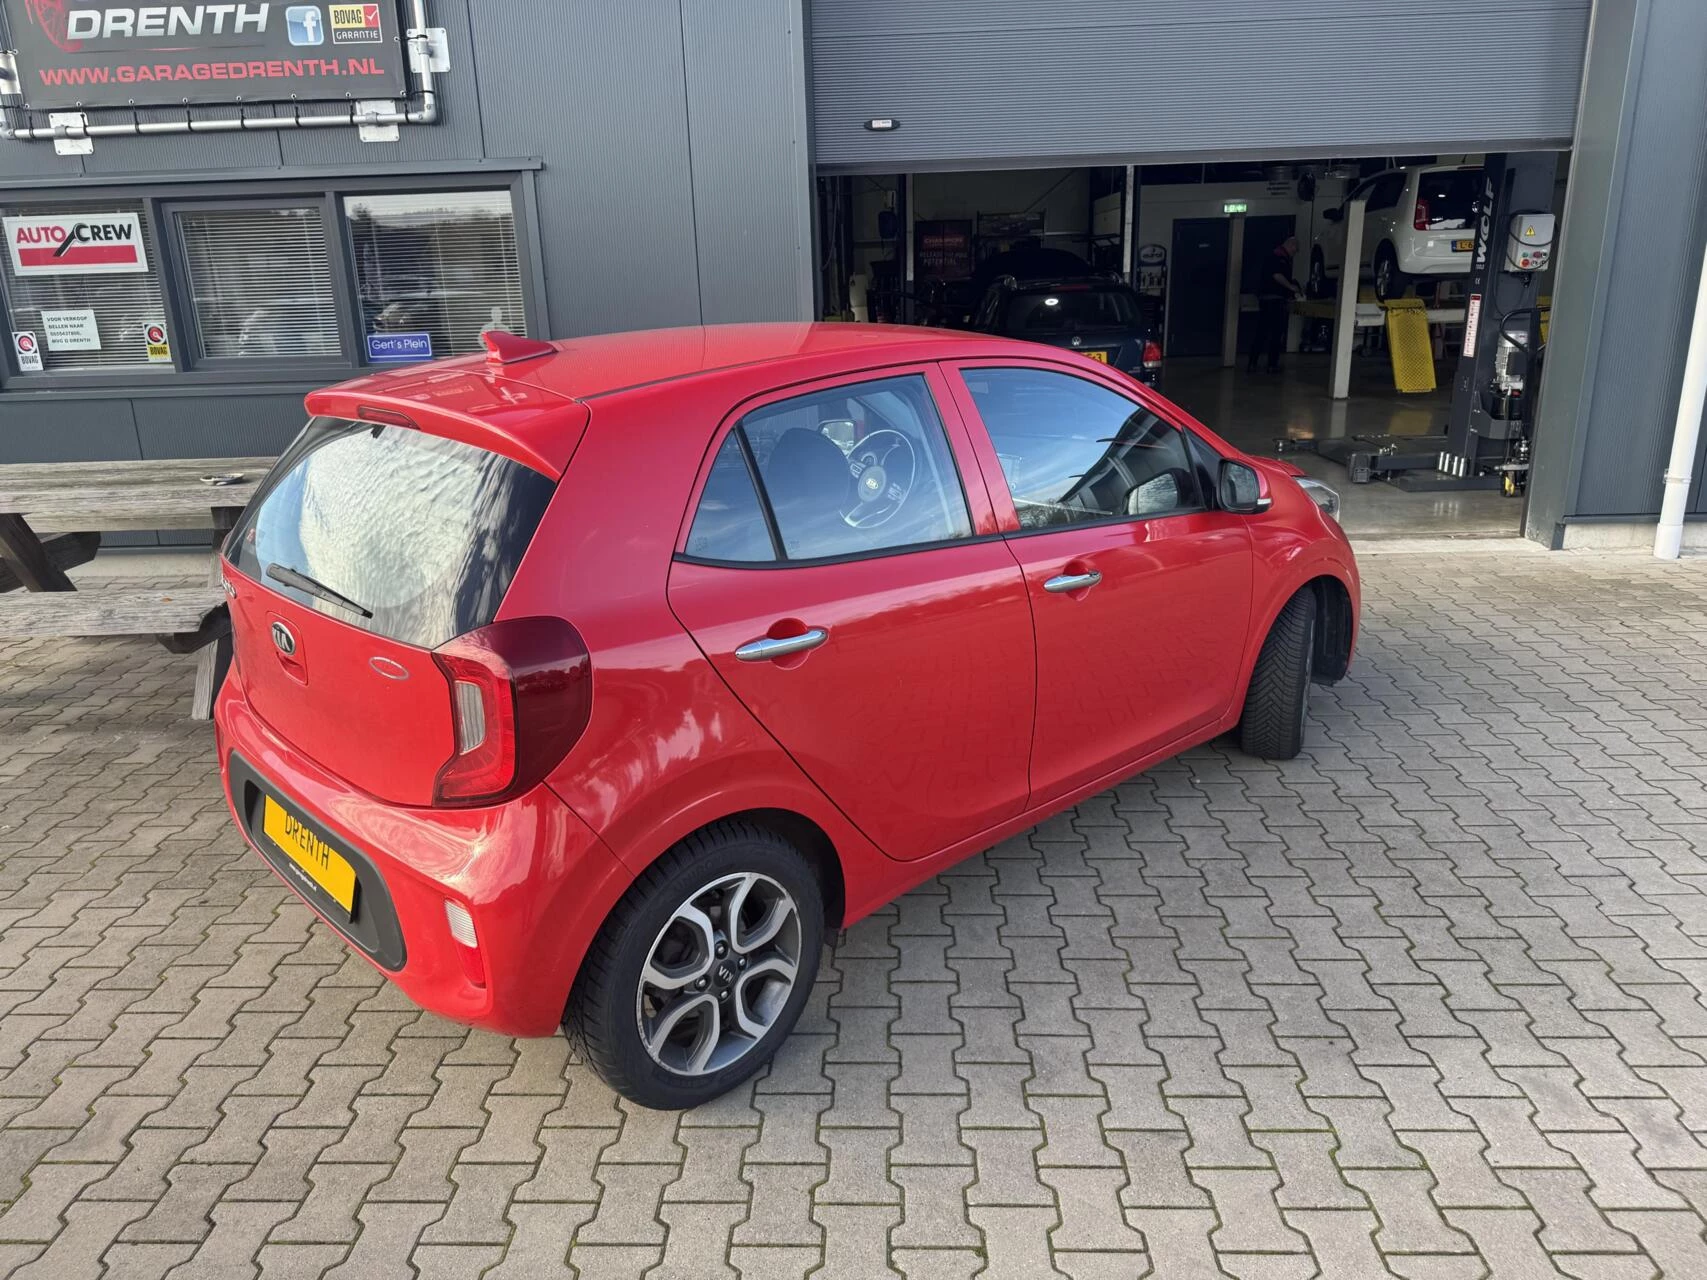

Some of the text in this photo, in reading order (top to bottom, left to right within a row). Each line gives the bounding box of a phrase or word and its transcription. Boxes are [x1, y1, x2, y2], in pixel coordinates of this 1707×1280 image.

[67, 3, 269, 40] DRENTH
[333, 9, 363, 24] BOVAG
[336, 30, 379, 40] GARANTIE
[39, 57, 385, 87] WWW.GARAGEDRENTH.NL
[16, 225, 67, 244] AUTO
[403, 339, 427, 349] Plein
[284, 814, 331, 871] DRENTH
